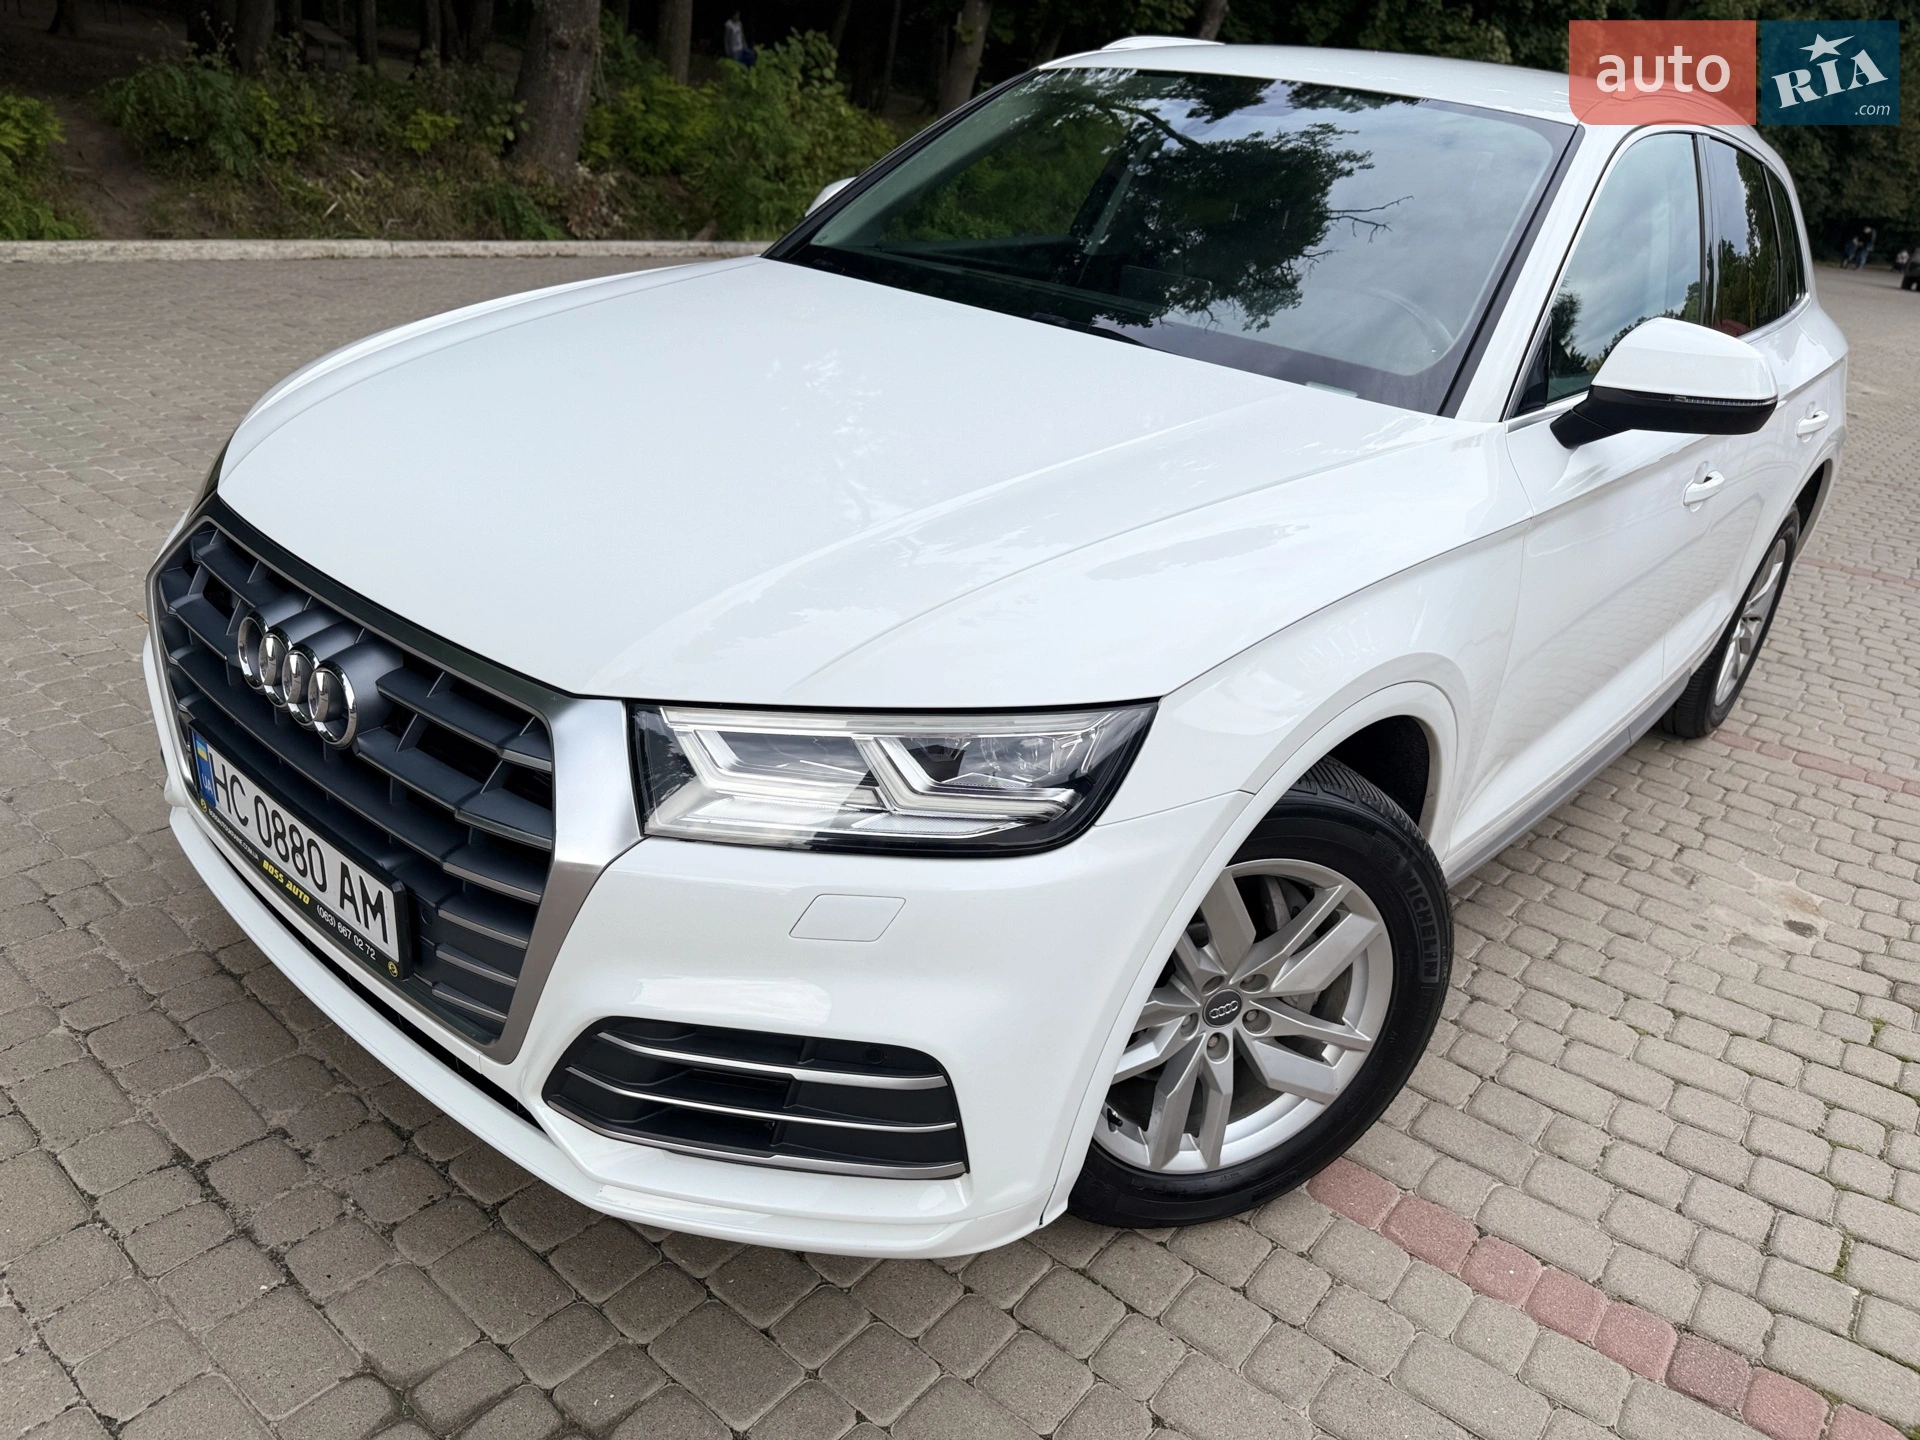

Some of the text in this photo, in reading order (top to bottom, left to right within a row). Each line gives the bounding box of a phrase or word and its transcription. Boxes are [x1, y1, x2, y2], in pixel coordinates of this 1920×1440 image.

[201, 772, 213, 795] UA
[209, 752, 249, 826] HC
[254, 795, 327, 892] 0880
[340, 861, 389, 945] AM
[262, 859, 284, 884] BOSS
[337, 921, 352, 940] 667
[353, 934, 364, 951] 02
[365, 943, 376, 960] 72
[1400, 867, 1438, 977] MICHELIN
